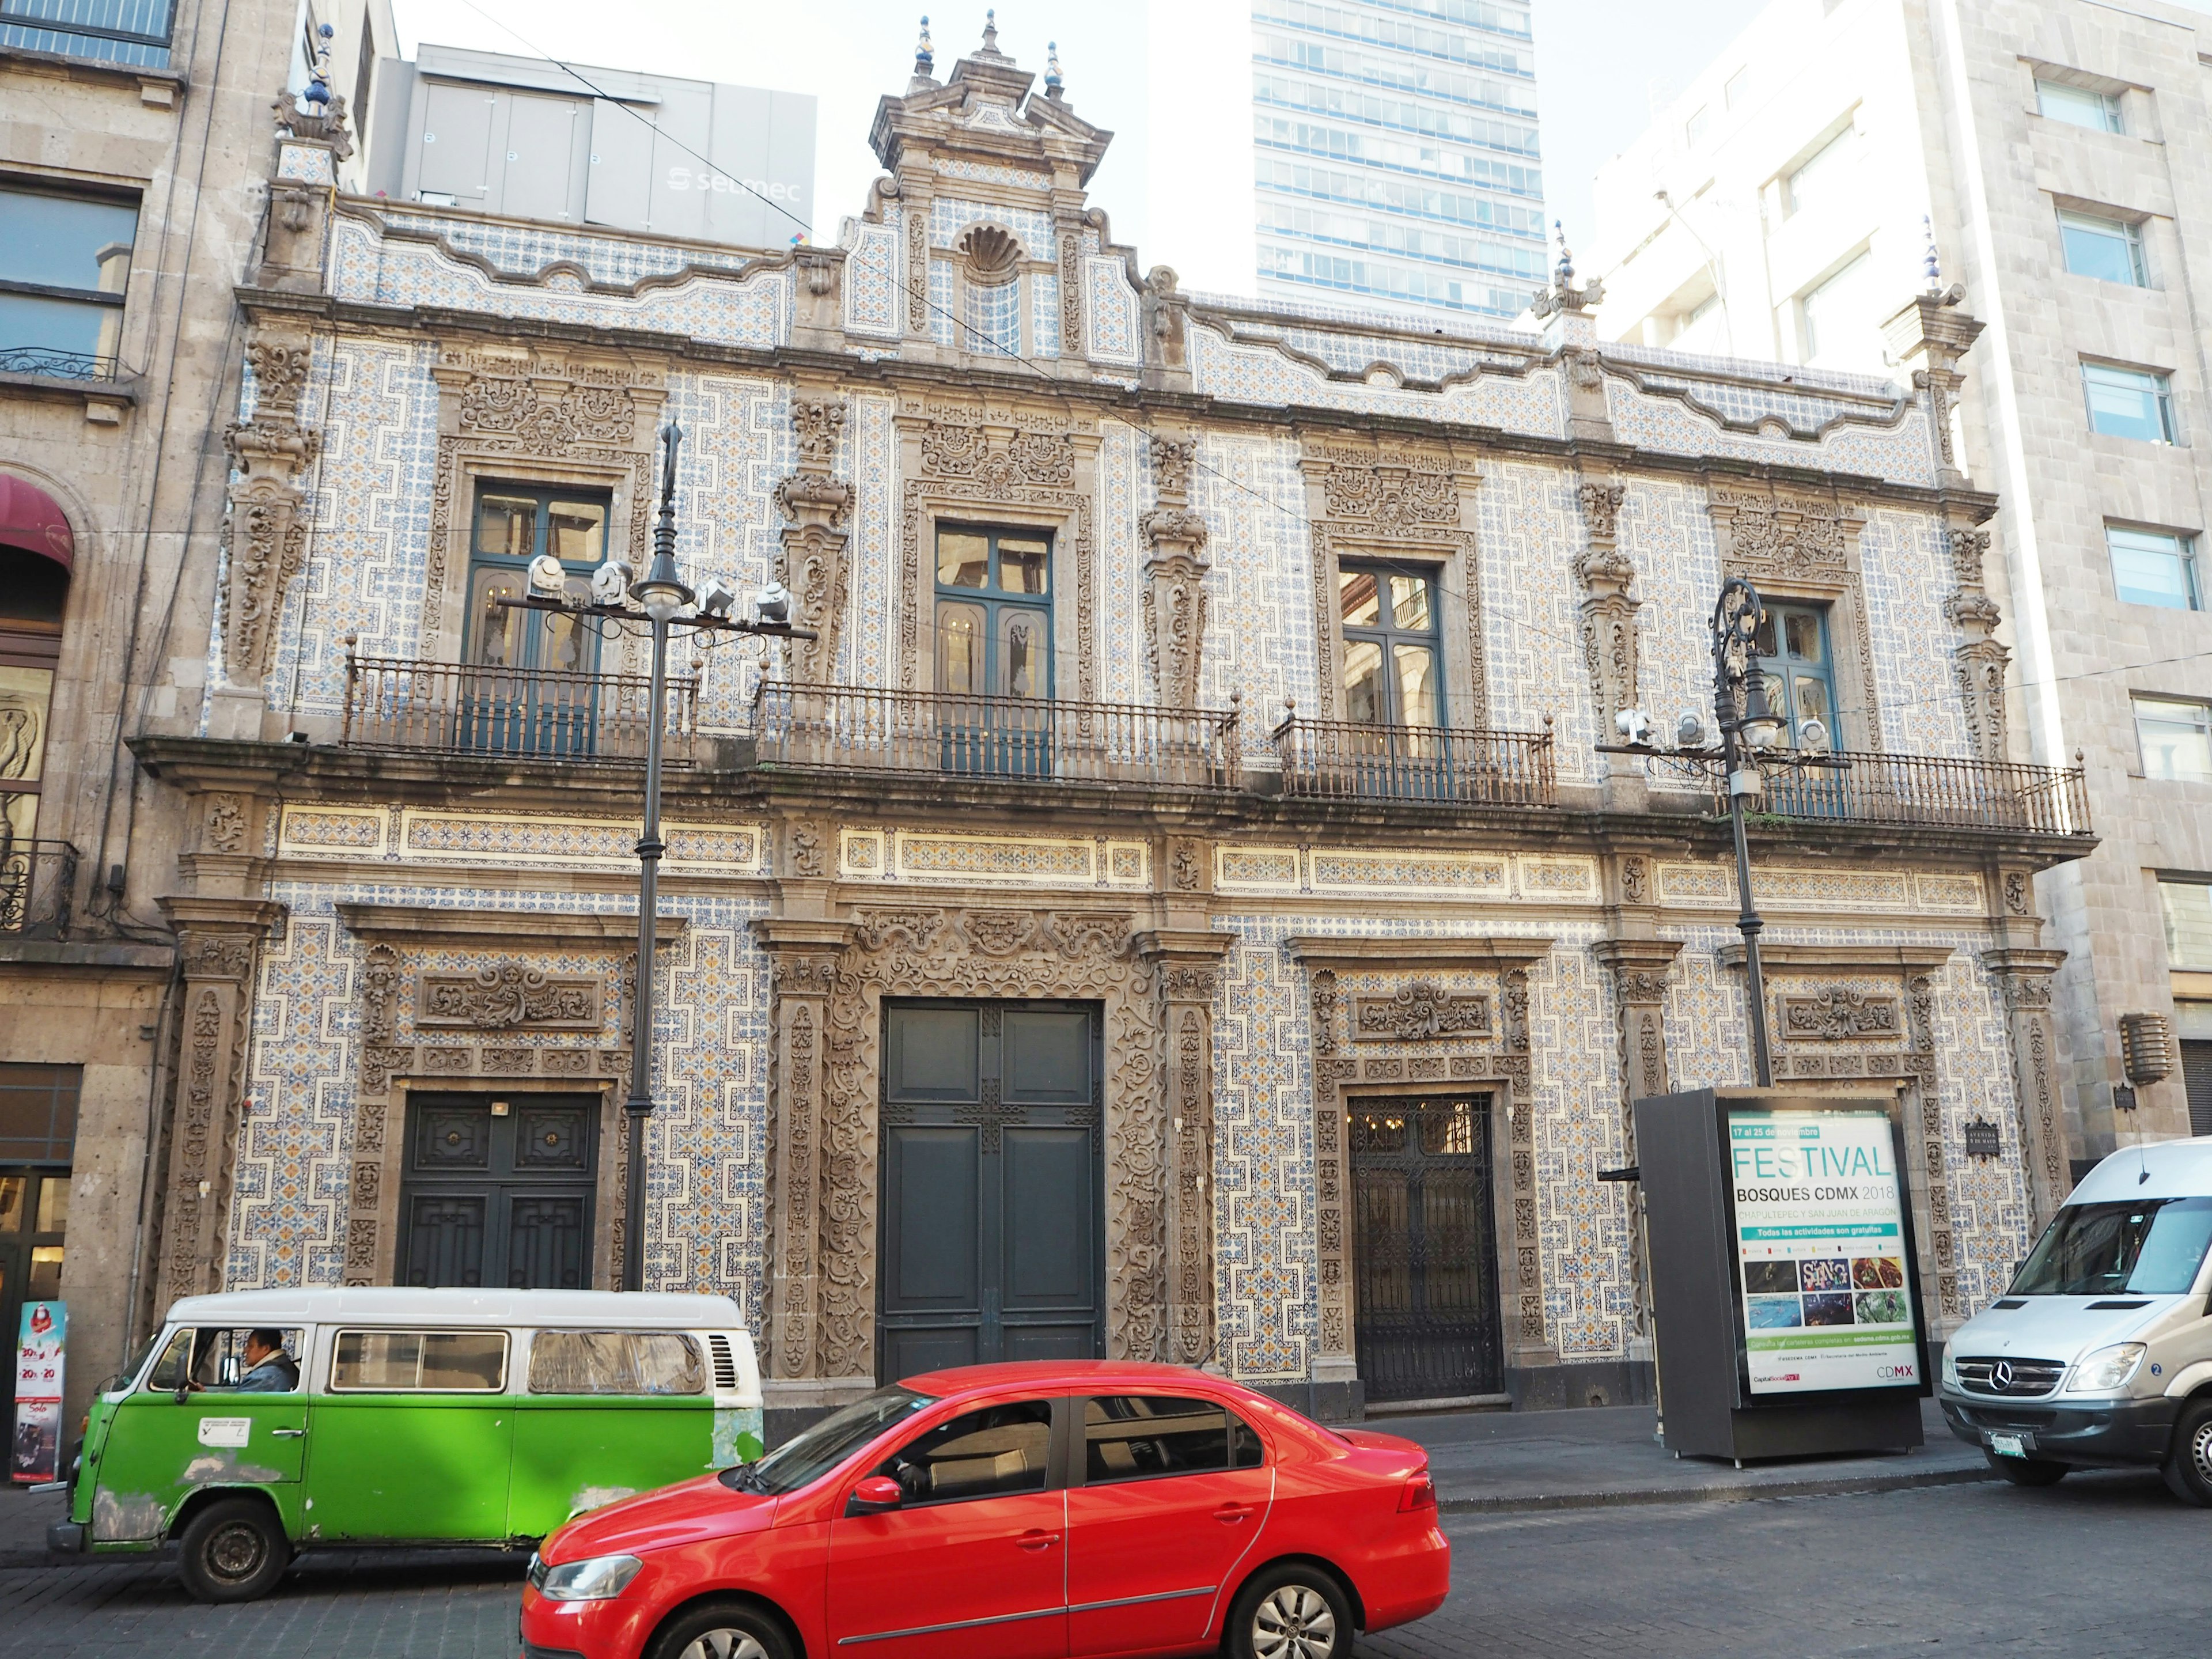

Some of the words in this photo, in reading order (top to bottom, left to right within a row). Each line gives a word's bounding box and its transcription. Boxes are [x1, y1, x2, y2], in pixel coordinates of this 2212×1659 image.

[696, 173, 801, 202] selmec
[1733, 1128, 1742, 1136] 17
[1744, 1128, 1752, 1136] al
[1753, 1128, 1763, 1136] 25
[1765, 1128, 1775, 1136] de
[1777, 1127, 1818, 1136] noviembre
[1733, 1146, 1892, 1179] FESTIVAL
[1737, 1188, 1810, 1202] BOSQUES
[1815, 1187, 1859, 1200] CDMX
[1862, 1186, 1895, 1199] 2018
[1738, 1210, 1798, 1219] CHAPULTEPEC
[1809, 1210, 1824, 1218] SAN
[1827, 1209, 1847, 1217] JUAN
[1850, 1209, 1861, 1217] DE
[1863, 1207, 1896, 1216] ARAGÓN
[1758, 1228, 1780, 1236] Todas
[1794, 1227, 1835, 1236] actividades
[1851, 1226, 1882, 1236] gratuitas
[1854, 1334, 1910, 1343] sedema.cdmx.gob.mx
[1877, 1365, 1913, 1378] CDMX
[2153, 1365, 2160, 1375] 2
[29, 1402, 47, 1412] Solo
